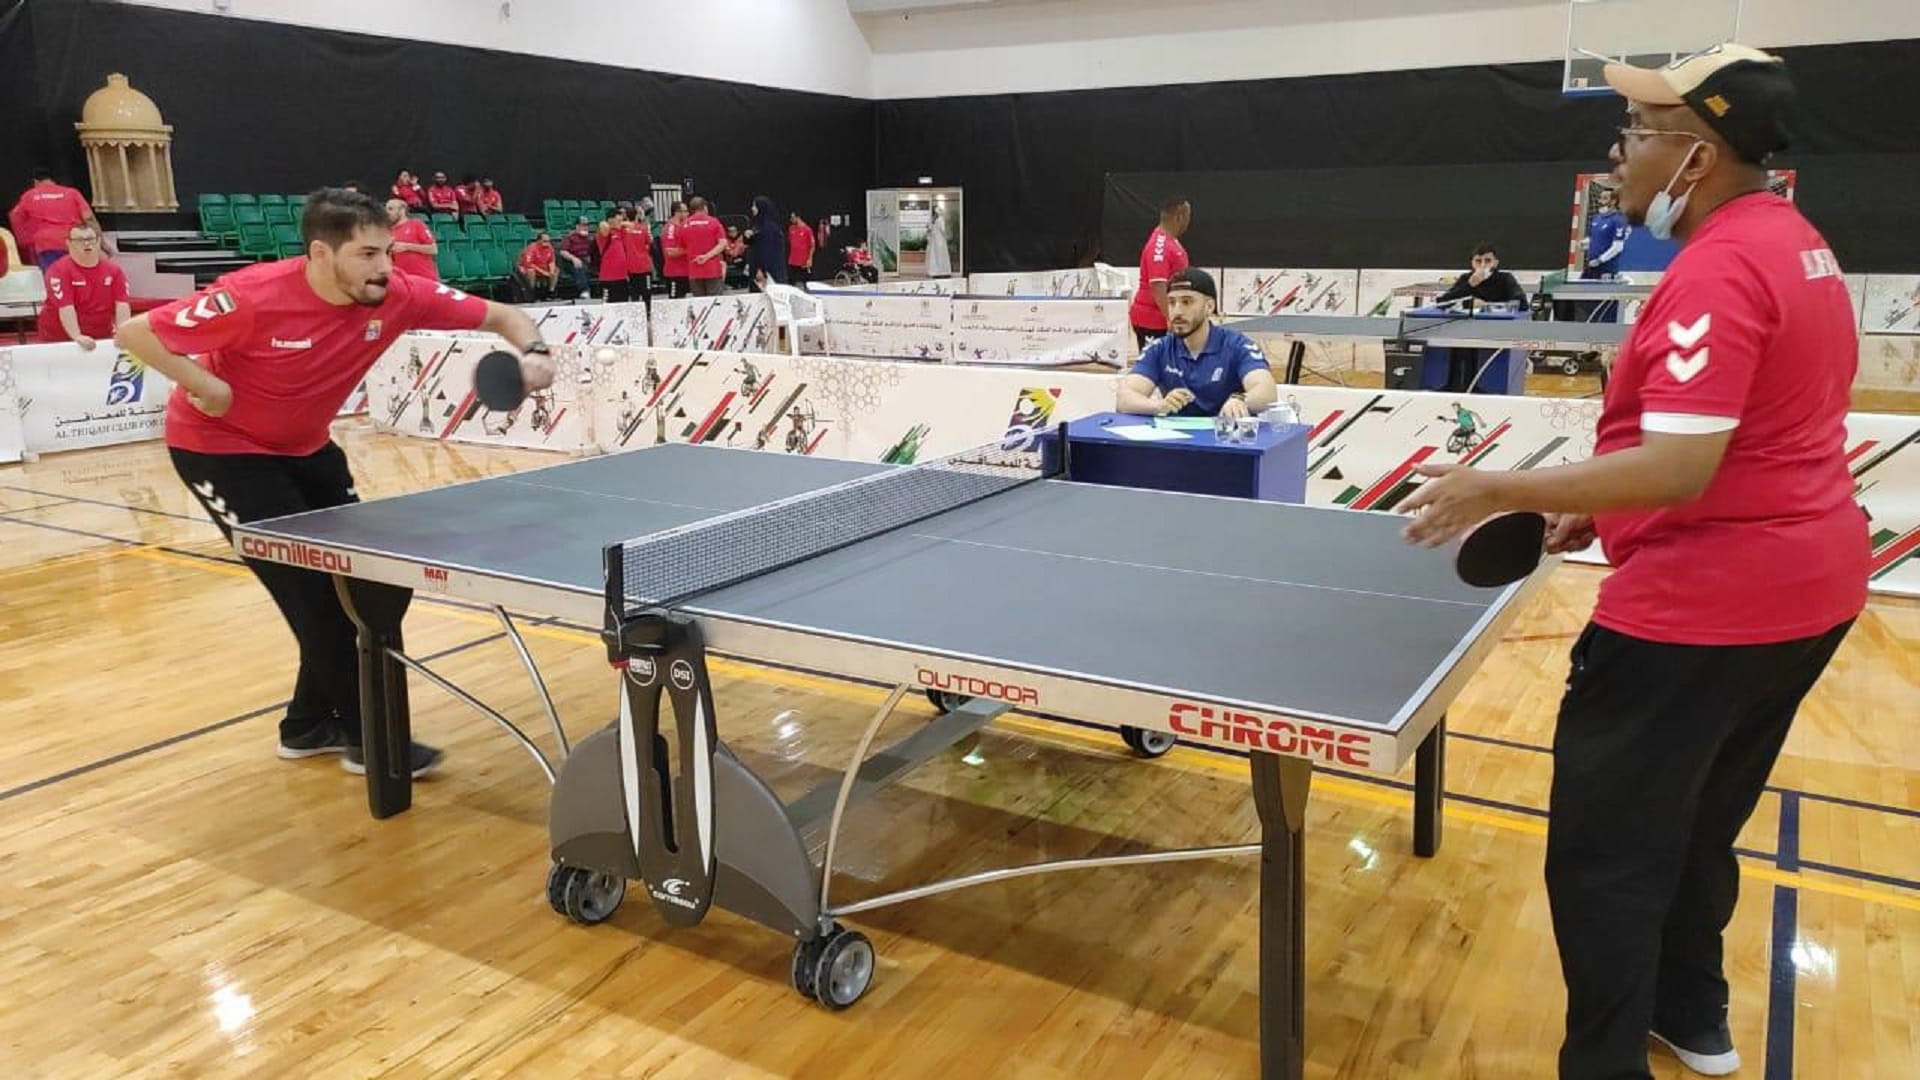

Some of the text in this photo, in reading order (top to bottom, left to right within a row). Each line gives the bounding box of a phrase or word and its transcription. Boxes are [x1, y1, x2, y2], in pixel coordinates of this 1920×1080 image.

[424, 566, 449, 581] MAT
[673, 668, 690, 681] DSI
[918, 668, 1038, 705] OUTDOOR
[1169, 703, 1370, 767] CHROME
